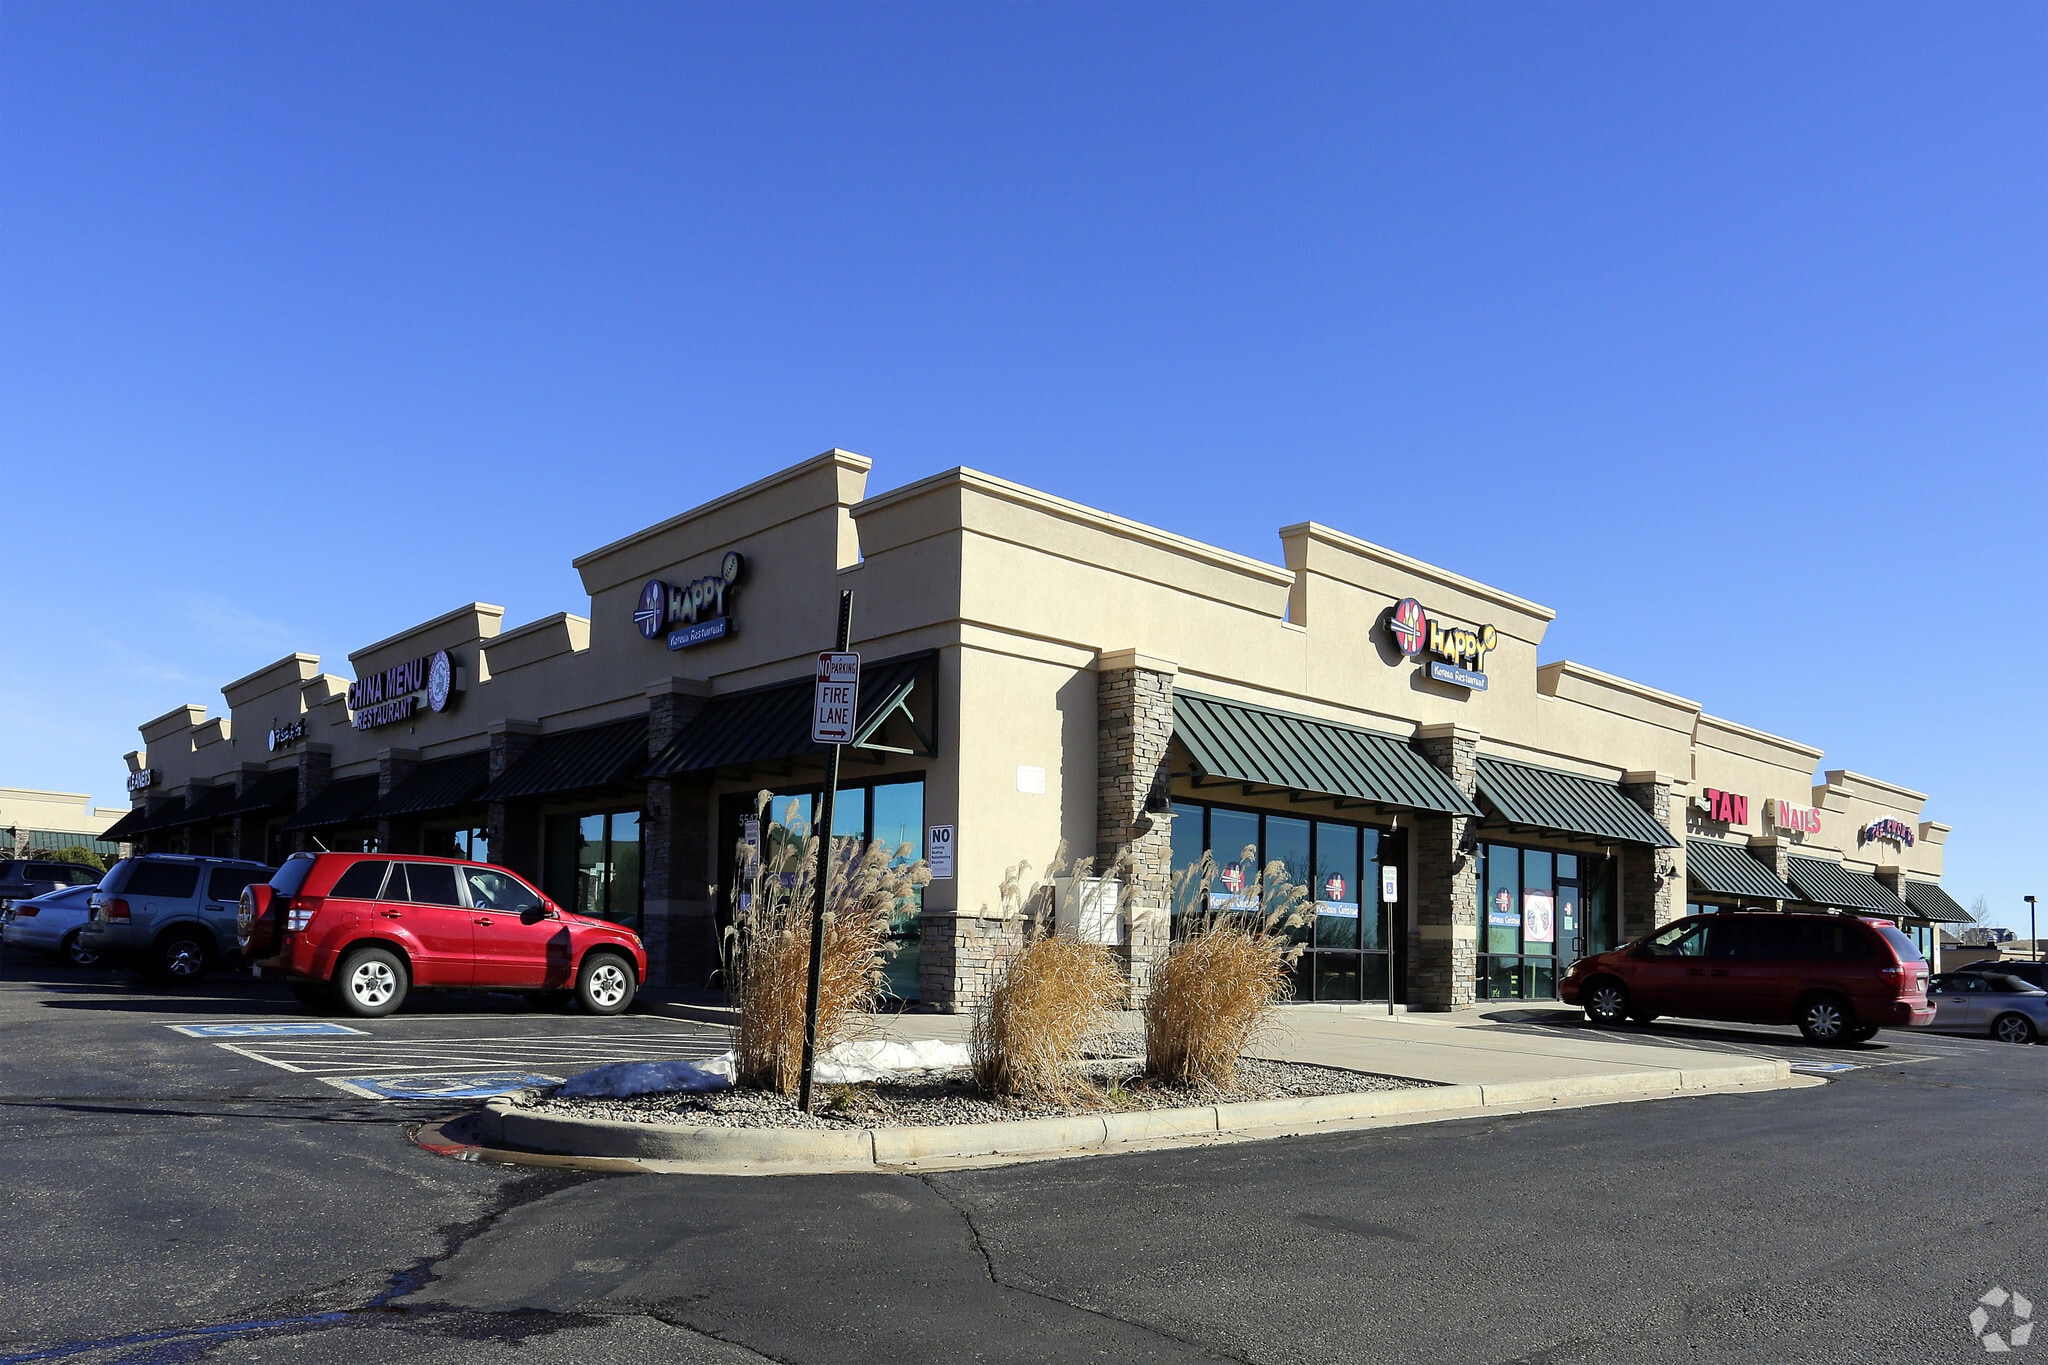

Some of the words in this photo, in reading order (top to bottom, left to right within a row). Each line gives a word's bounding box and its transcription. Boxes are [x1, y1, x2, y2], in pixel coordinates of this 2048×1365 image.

[668, 576, 727, 623] HAPPY
[1430, 619, 1487, 673] HAPPY
[347, 673, 383, 710] CHINA
[386, 657, 424, 700] MENU
[818, 659, 831, 677] NO
[831, 661, 856, 675] PARKING
[1434, 665, 1454, 680] Korean
[822, 687, 850, 704] FIRE
[357, 696, 413, 731] RESTAURANT
[819, 708, 849, 725] LANE
[1708, 788, 1748, 825] TAN
[1779, 800, 1821, 834] NAILS
[932, 828, 951, 843] NO
